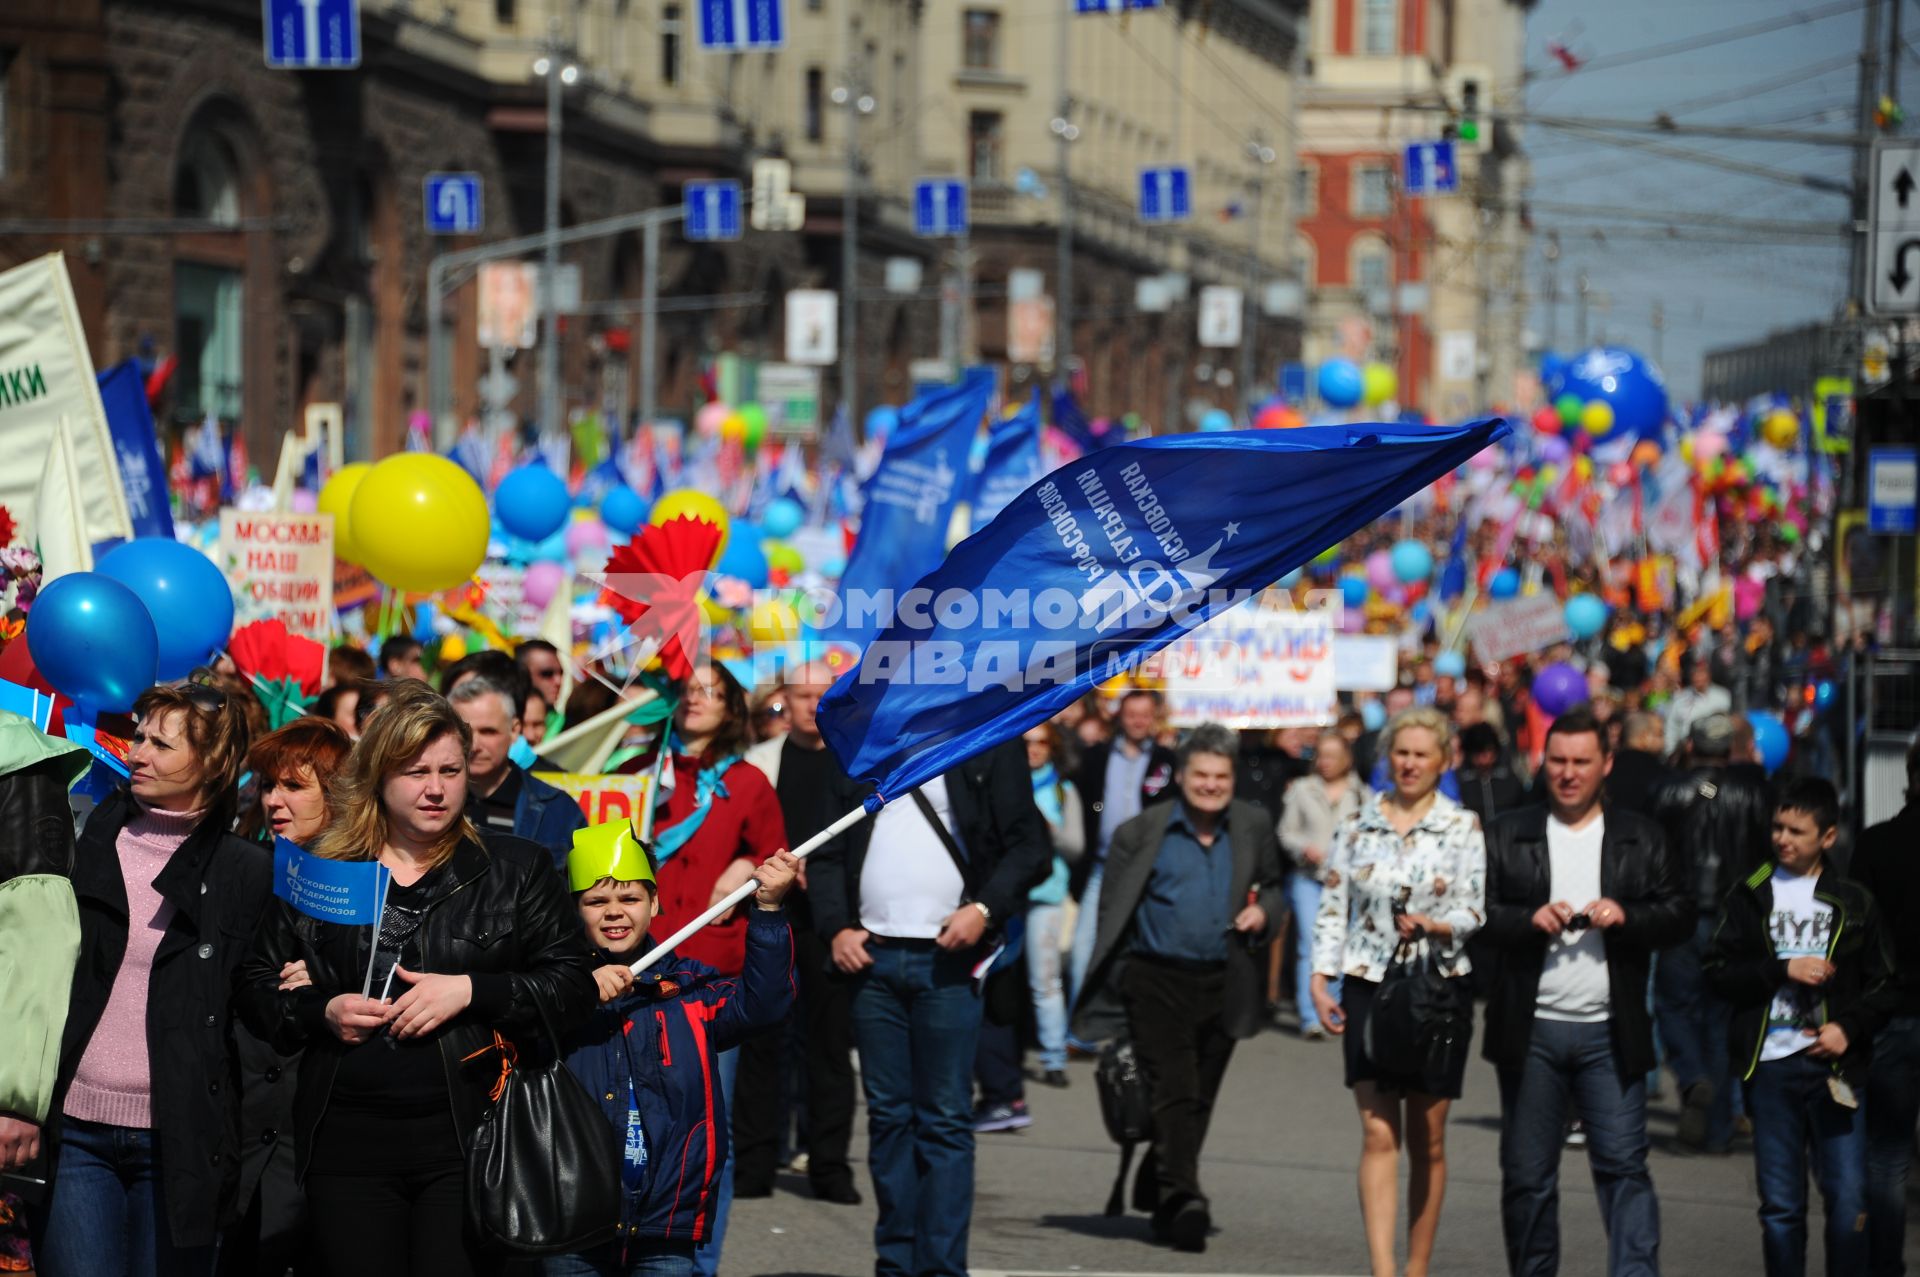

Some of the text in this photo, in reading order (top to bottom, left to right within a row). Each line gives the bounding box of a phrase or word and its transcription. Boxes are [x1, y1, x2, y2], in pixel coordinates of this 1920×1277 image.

[247, 550, 299, 574] НАШ
[251, 579, 319, 604] ОБЩИЙ
[286, 856, 350, 894] МОСКОВСКАЯ
[286, 876, 351, 905] ФЕДЕРАЦИЯ
[289, 889, 357, 917] ПРОФСОЮЗОВ
